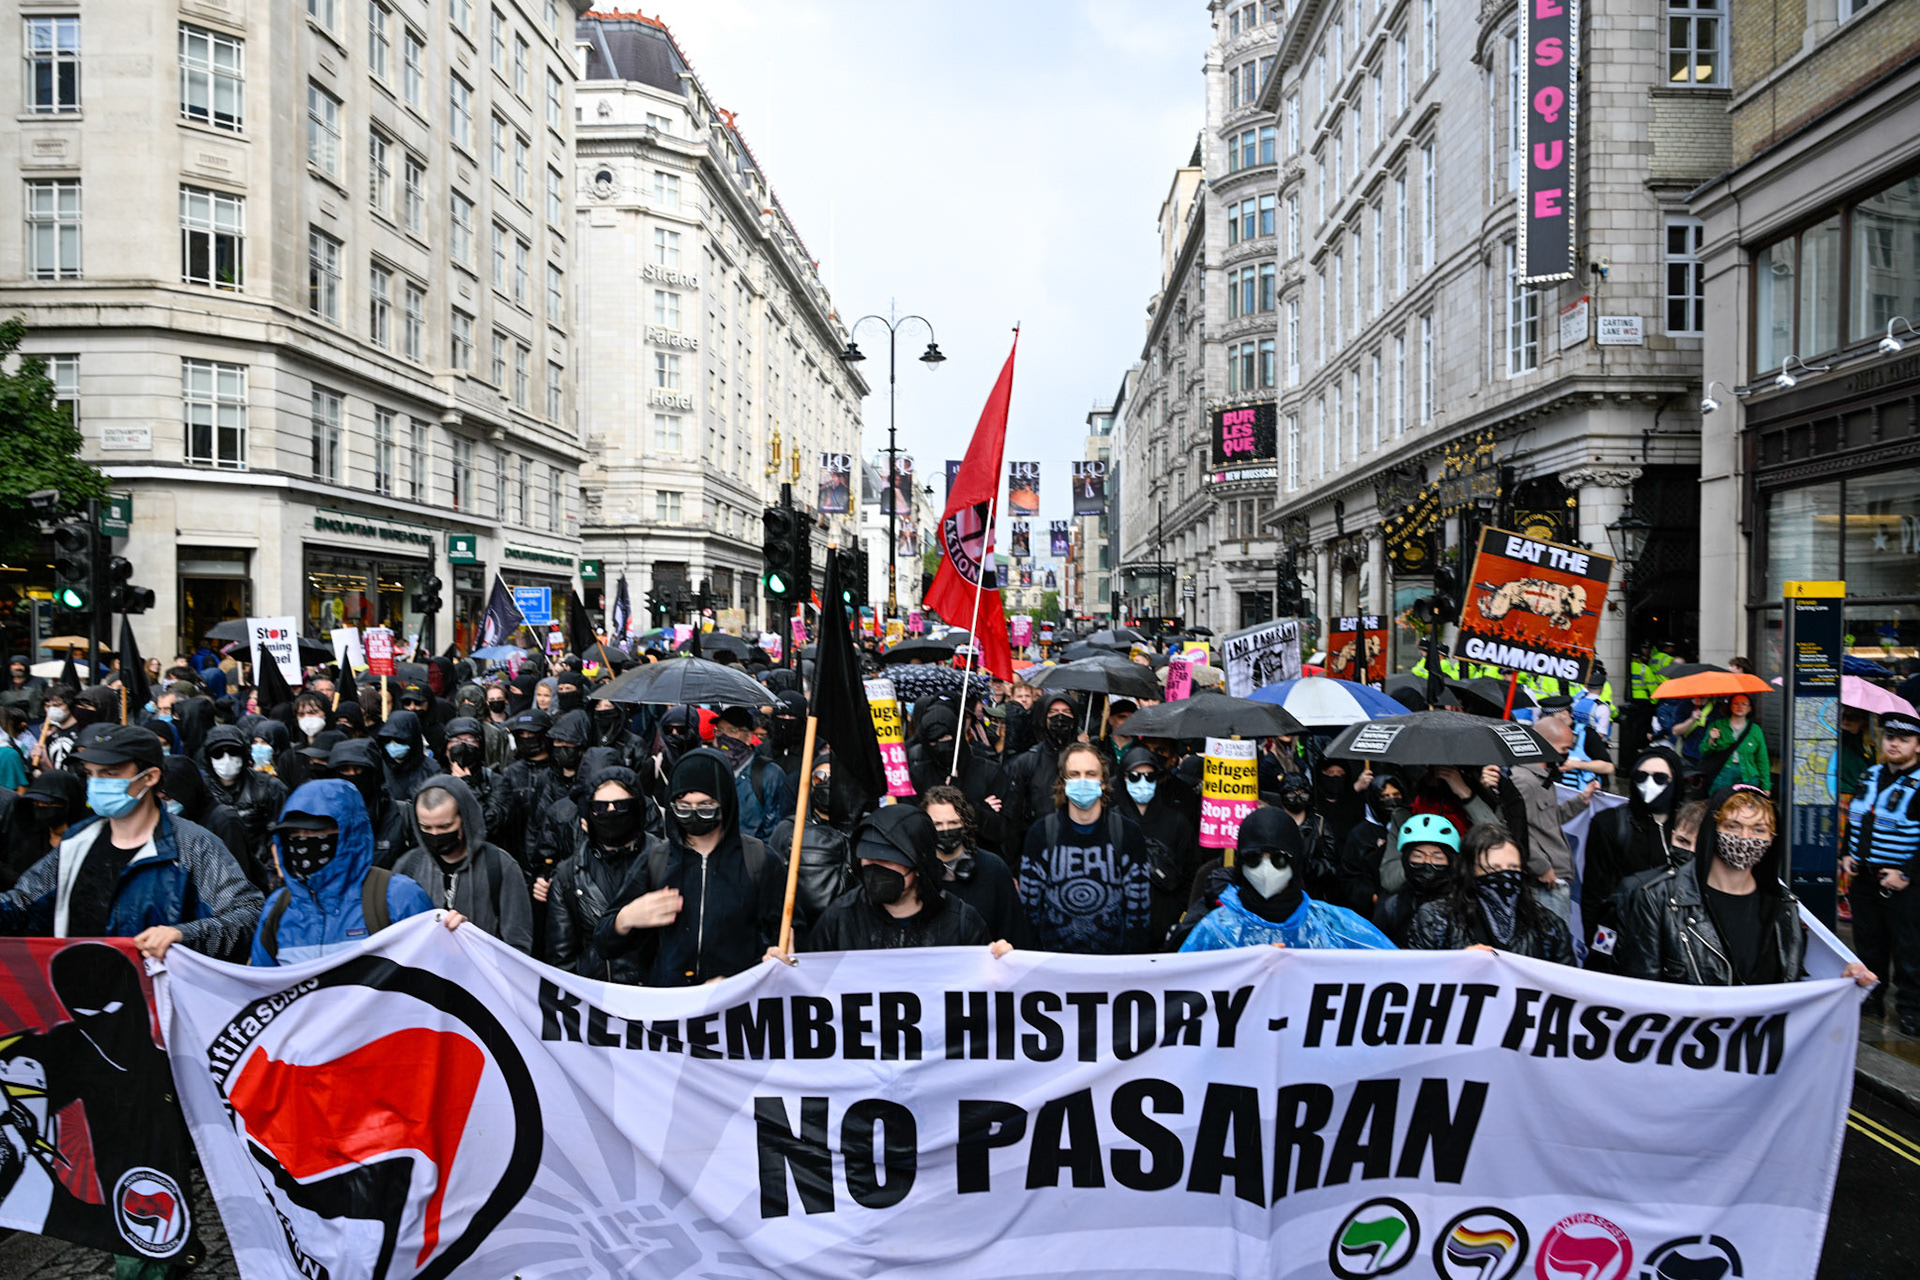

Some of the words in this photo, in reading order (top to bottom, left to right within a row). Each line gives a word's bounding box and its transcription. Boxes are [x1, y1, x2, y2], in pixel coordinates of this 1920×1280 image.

[1533, 0, 1564, 219] ESQUE
[642, 263, 699, 289] Strand
[1602, 319, 1633, 327] CARTING
[1602, 327, 1620, 335] LANE
[1622, 327, 1639, 335] WC2
[644, 325, 700, 351] Palace
[648, 388, 693, 410] Hotel
[1223, 409, 1255, 426] BUR
[1223, 423, 1253, 440] LES
[1223, 437, 1255, 457] QUE
[1225, 470, 1240, 481] NEW
[1241, 467, 1277, 480] MUSICAL
[320, 516, 376, 537] MOUNTAIN
[946, 519, 980, 582] AKTION
[1505, 535, 1548, 564] EAT
[1548, 546, 1590, 575] THE
[1340, 617, 1359, 631] EAT
[1465, 637, 1580, 681] GAMMONS
[1206, 758, 1257, 780] Refugee
[1201, 800, 1231, 821] Stop
[1220, 821, 1240, 840] rig
[539, 977, 922, 1060] REMEMBER
[944, 990, 1255, 1062] HISTORY
[1268, 1016, 1288, 1031] -
[1302, 983, 1500, 1048] FIGHT
[1500, 988, 1789, 1075] FASCISM
[753, 1096, 917, 1219] NO
[956, 1078, 1490, 1208] PASARAN
[1555, 1213, 1628, 1242] ANTIFASCIST
